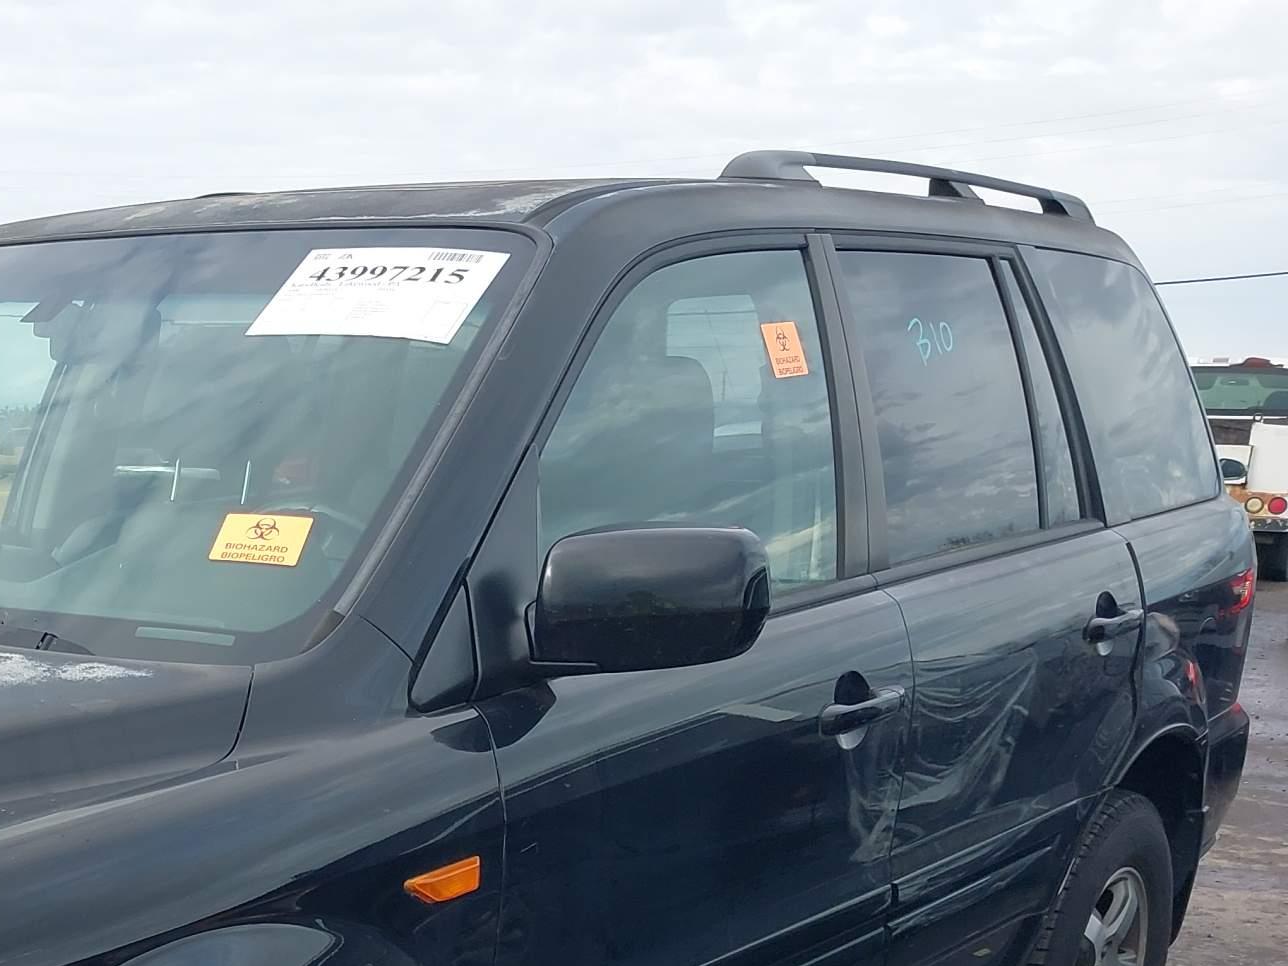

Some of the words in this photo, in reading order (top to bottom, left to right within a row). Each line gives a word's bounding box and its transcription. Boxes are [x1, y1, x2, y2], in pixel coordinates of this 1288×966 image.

[309, 265, 470, 284] 43997215
[224, 542, 289, 554] BIOHAZARD
[220, 551, 285, 563] BIOPELIGRO
